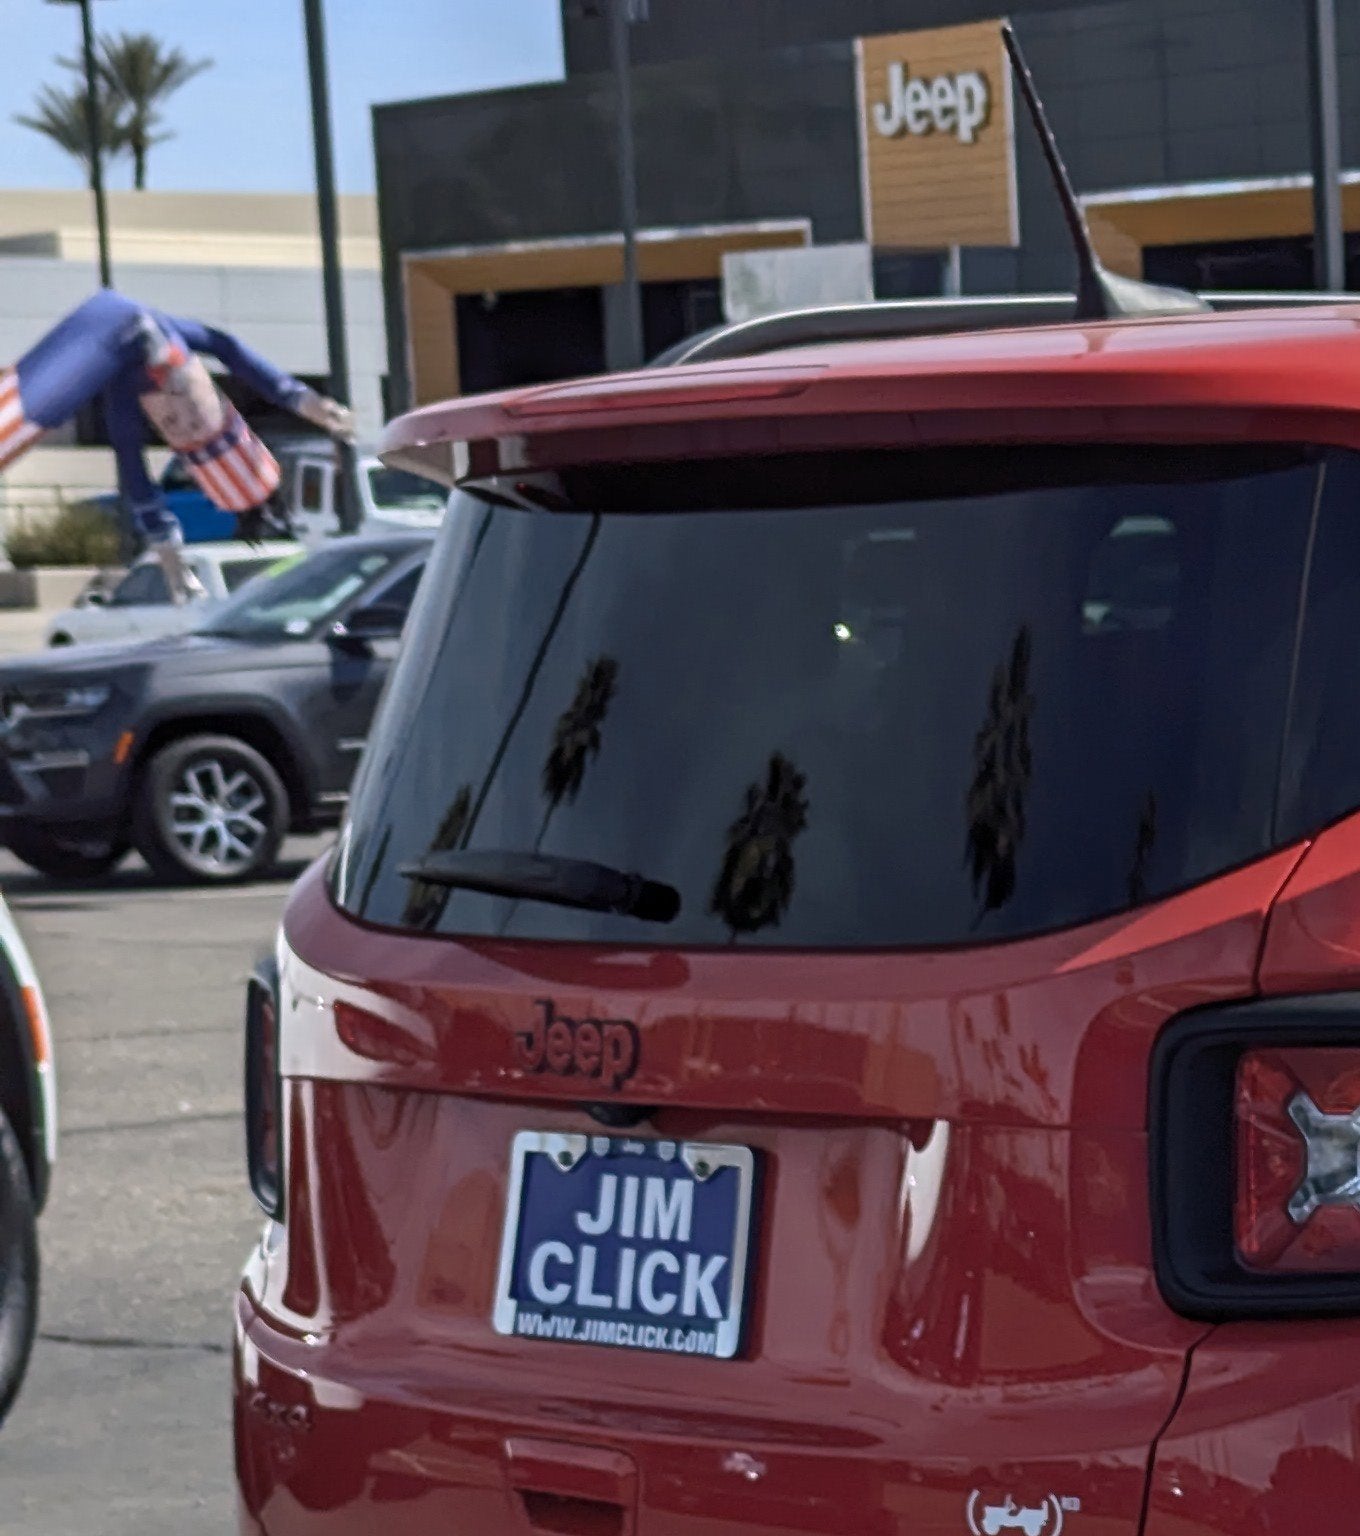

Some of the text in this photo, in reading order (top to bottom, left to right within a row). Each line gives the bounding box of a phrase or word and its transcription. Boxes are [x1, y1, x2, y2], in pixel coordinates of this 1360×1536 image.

[873, 61, 988, 144] Jeep
[515, 999, 640, 1092] Jeep
[575, 1173, 695, 1242] JIM
[528, 1240, 729, 1319] CLICK
[518, 1311, 717, 1355] WWW.JIMCLICK.COM
